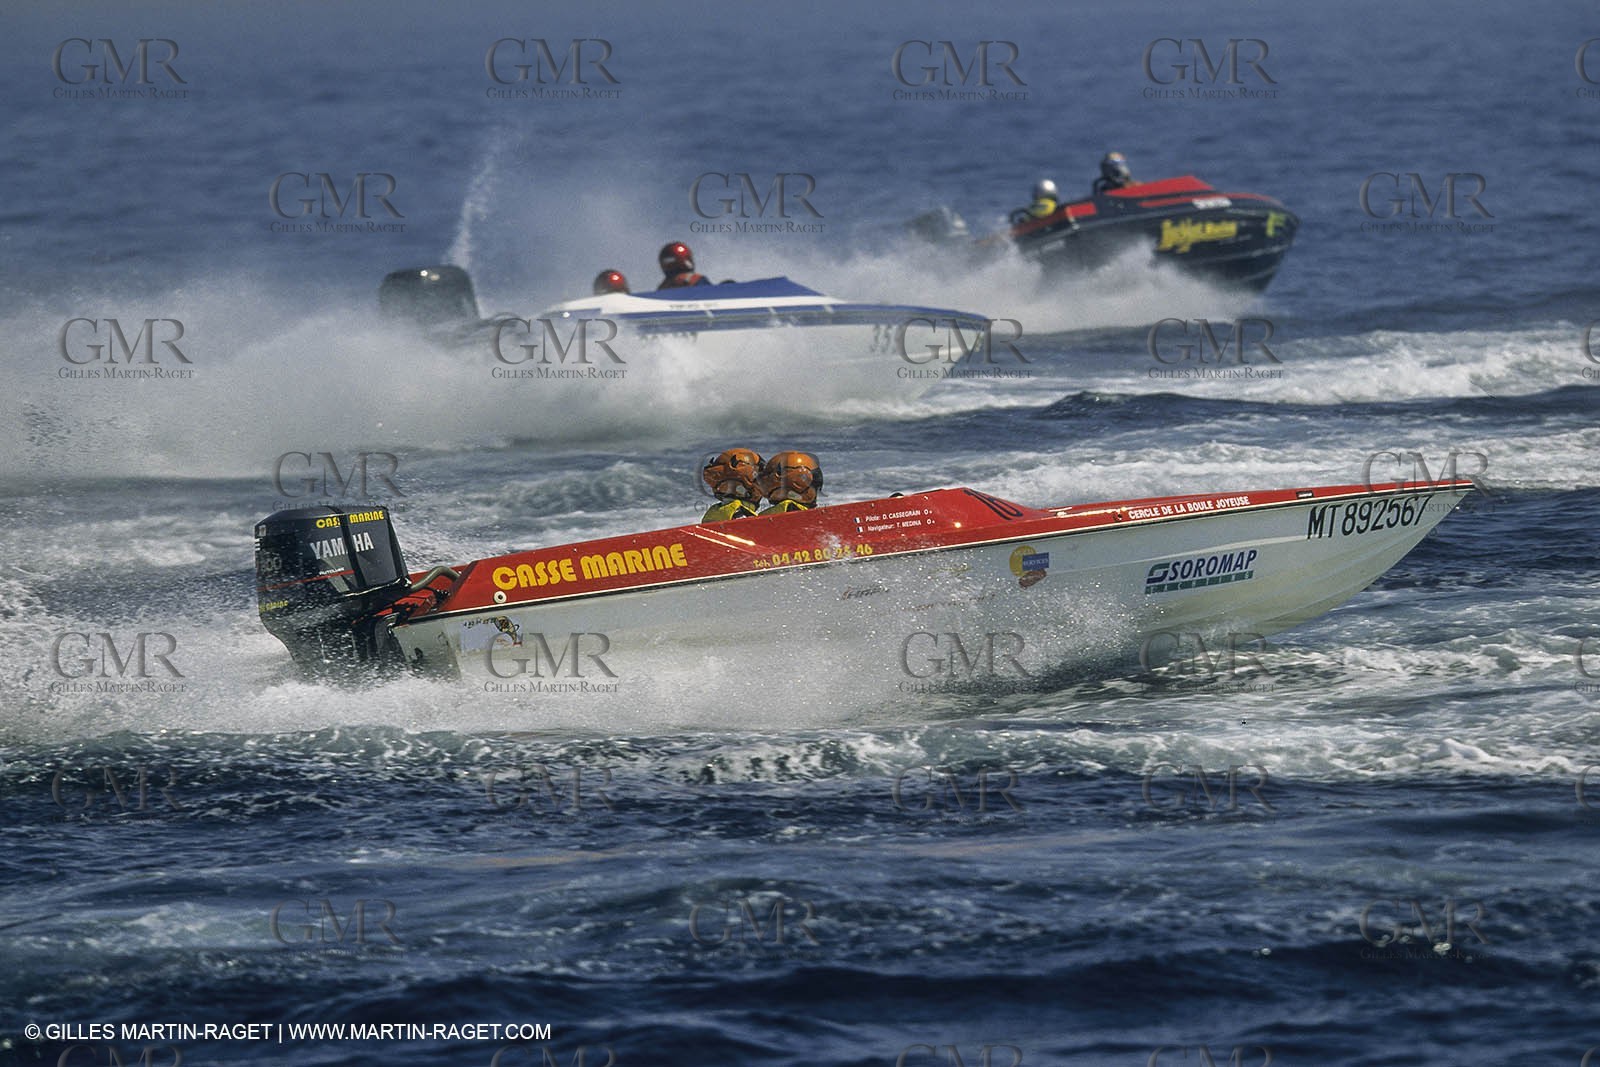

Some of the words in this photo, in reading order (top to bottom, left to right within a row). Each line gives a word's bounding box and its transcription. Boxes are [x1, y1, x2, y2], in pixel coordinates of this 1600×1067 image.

[349, 510, 385, 524] MARINE
[888, 510, 921, 519] CASSEGRAIN
[1128, 507, 1160, 520] CERCLE
[1162, 505, 1173, 516] DE
[1174, 503, 1187, 514] LA
[1188, 500, 1214, 512] BOULE
[1215, 495, 1250, 508] JOYEUSE
[309, 531, 375, 560] YAMHA
[793, 550, 812, 563] 42
[855, 543, 873, 556] 46
[492, 558, 577, 591] CASSE
[580, 543, 688, 580] MARINE
[1168, 549, 1258, 582] SOROMAP
